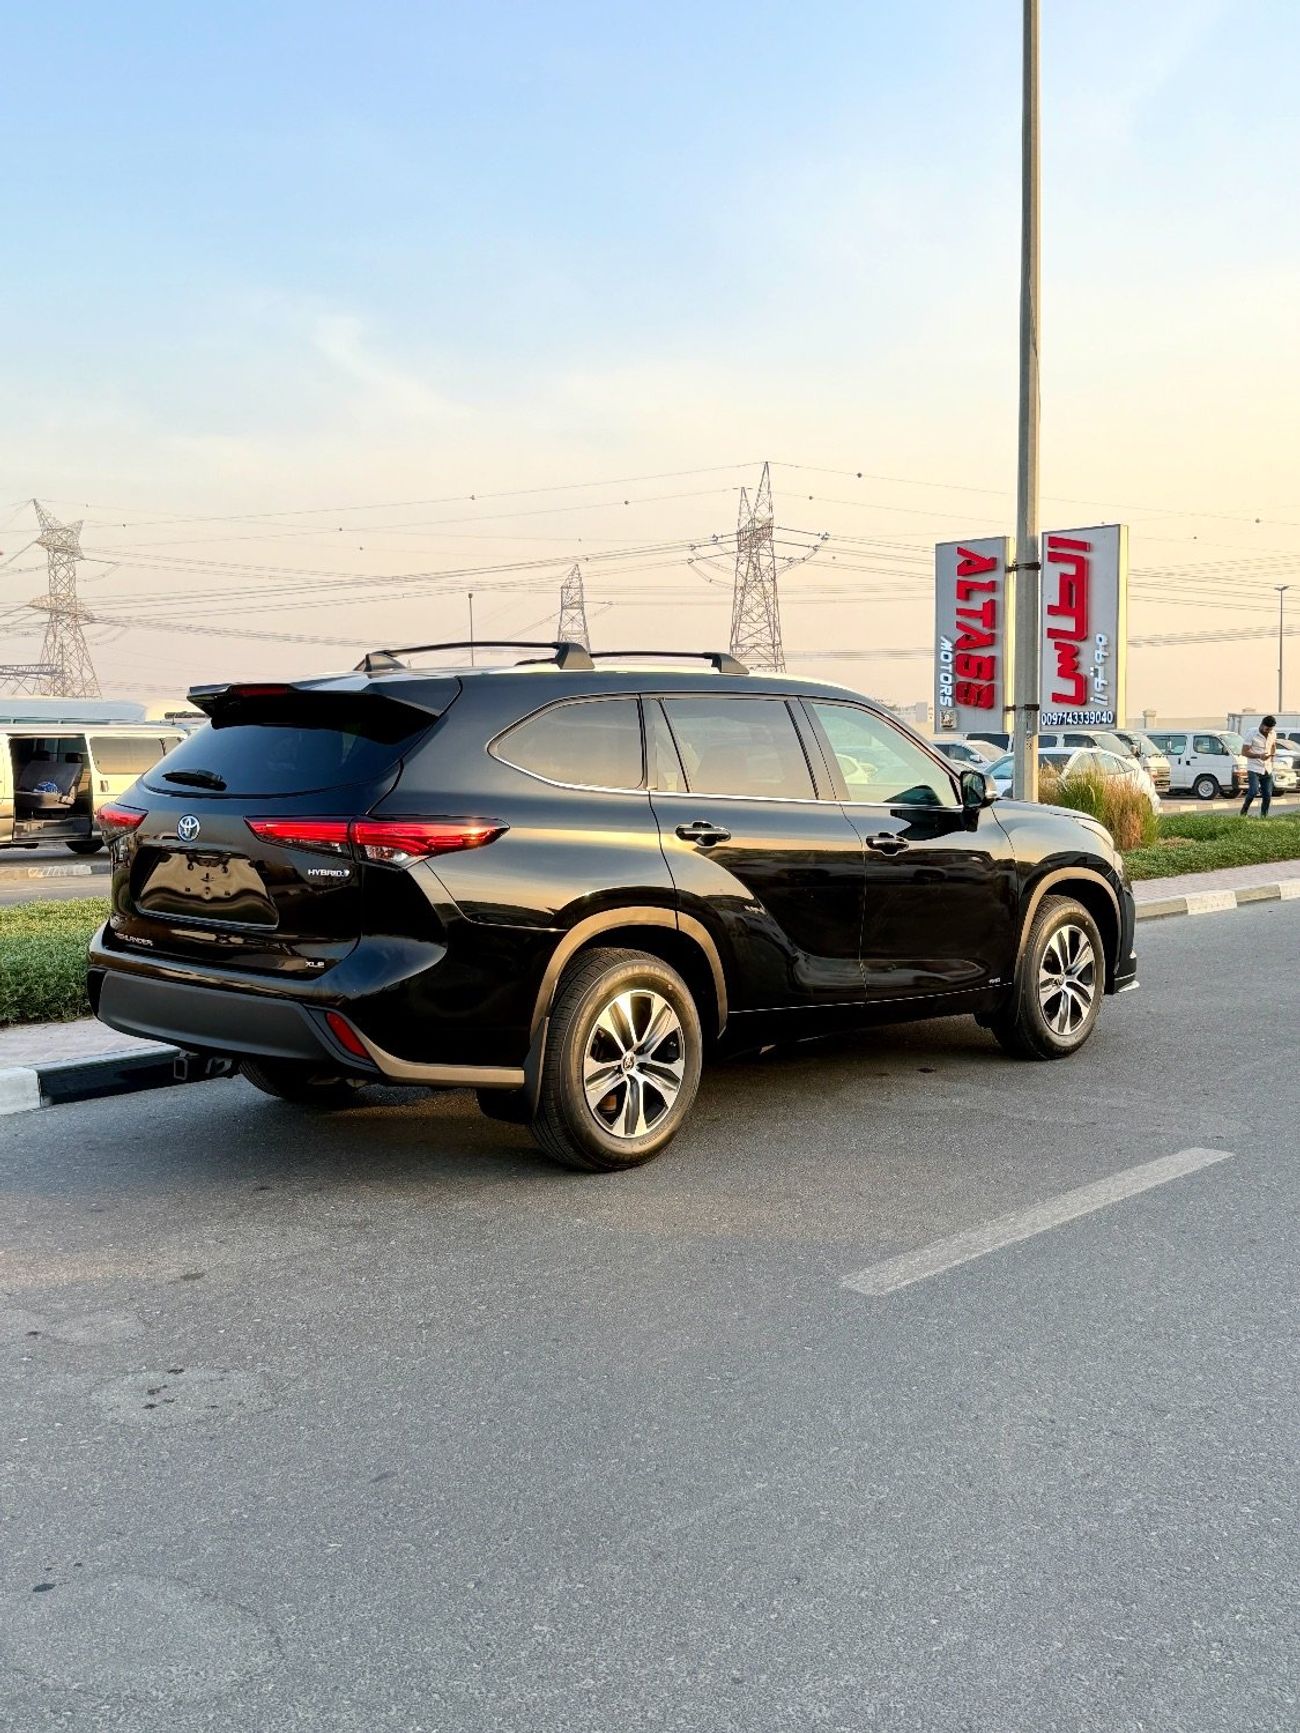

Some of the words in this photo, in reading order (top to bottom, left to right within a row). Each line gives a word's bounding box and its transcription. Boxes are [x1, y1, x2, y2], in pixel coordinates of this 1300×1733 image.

[1046, 535, 1090, 706] الطاس
[939, 635, 954, 707] MOTORS
[1089, 633, 1109, 706] موتورز
[1041, 711, 1114, 726] 0097143339040
[307, 868, 343, 878] HYBRID
[305, 961, 325, 969] XLE
